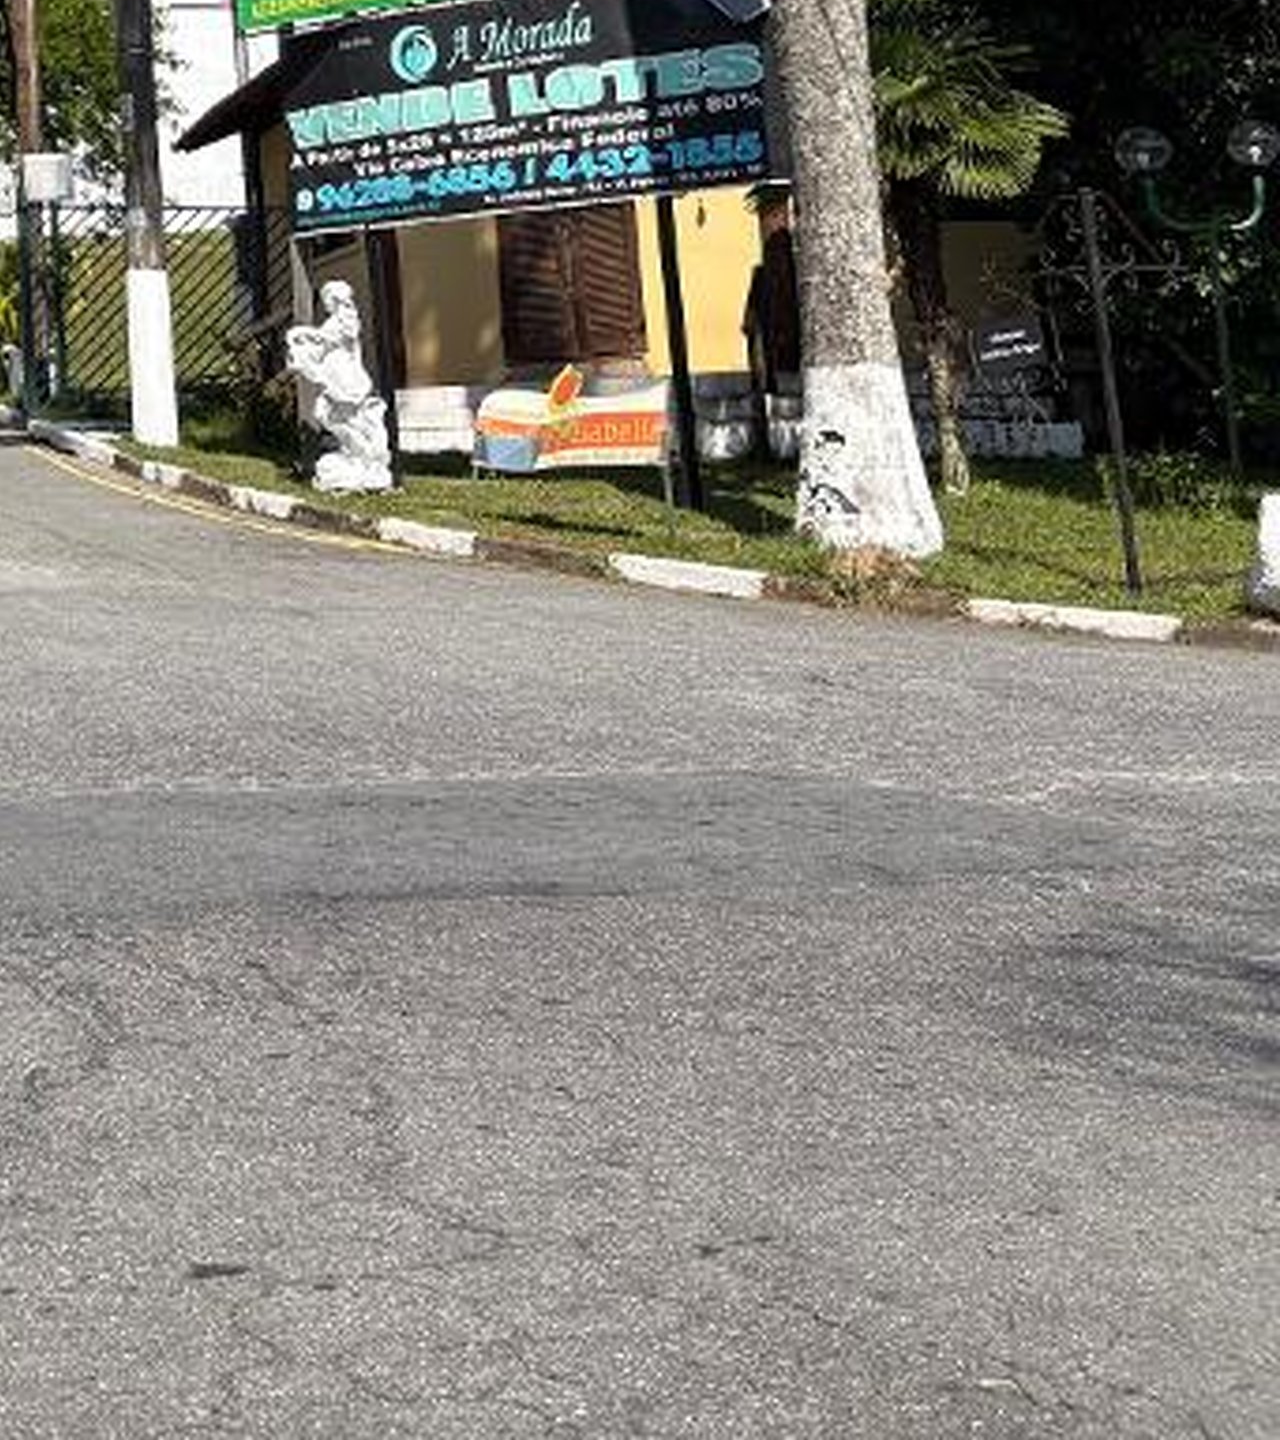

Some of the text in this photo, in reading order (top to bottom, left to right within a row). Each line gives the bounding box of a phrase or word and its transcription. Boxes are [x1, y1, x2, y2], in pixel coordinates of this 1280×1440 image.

[481, 0, 592, 58] Morada
[286, 42, 764, 150] VENDE LOTES
[703, 91, 764, 114] 80%
